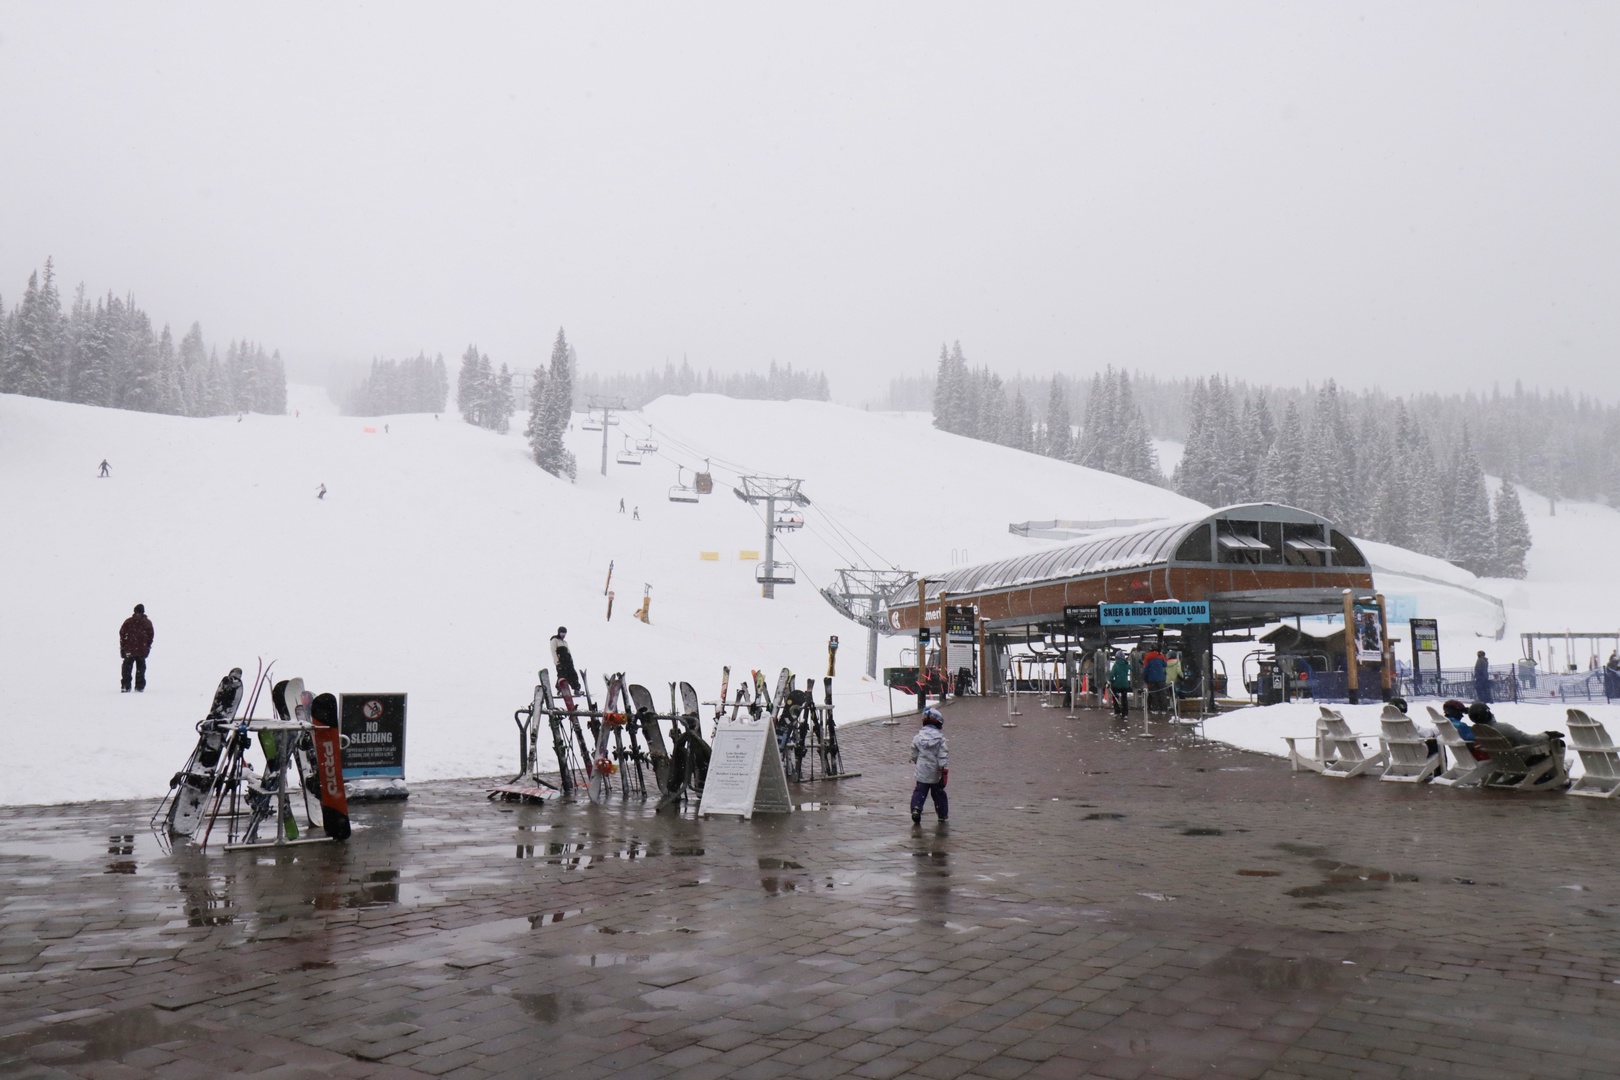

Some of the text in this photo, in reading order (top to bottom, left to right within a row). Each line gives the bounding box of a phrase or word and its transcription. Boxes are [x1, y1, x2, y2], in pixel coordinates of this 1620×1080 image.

[1103, 608, 1123, 617] SKIER
[1124, 607, 1131, 616] &
[1131, 607, 1152, 616] RIDER
[1153, 606, 1186, 616] GONDOLA
[1187, 605, 1206, 615] LOAD
[366, 722, 379, 732] NO
[351, 732, 393, 744] SLEDDING
